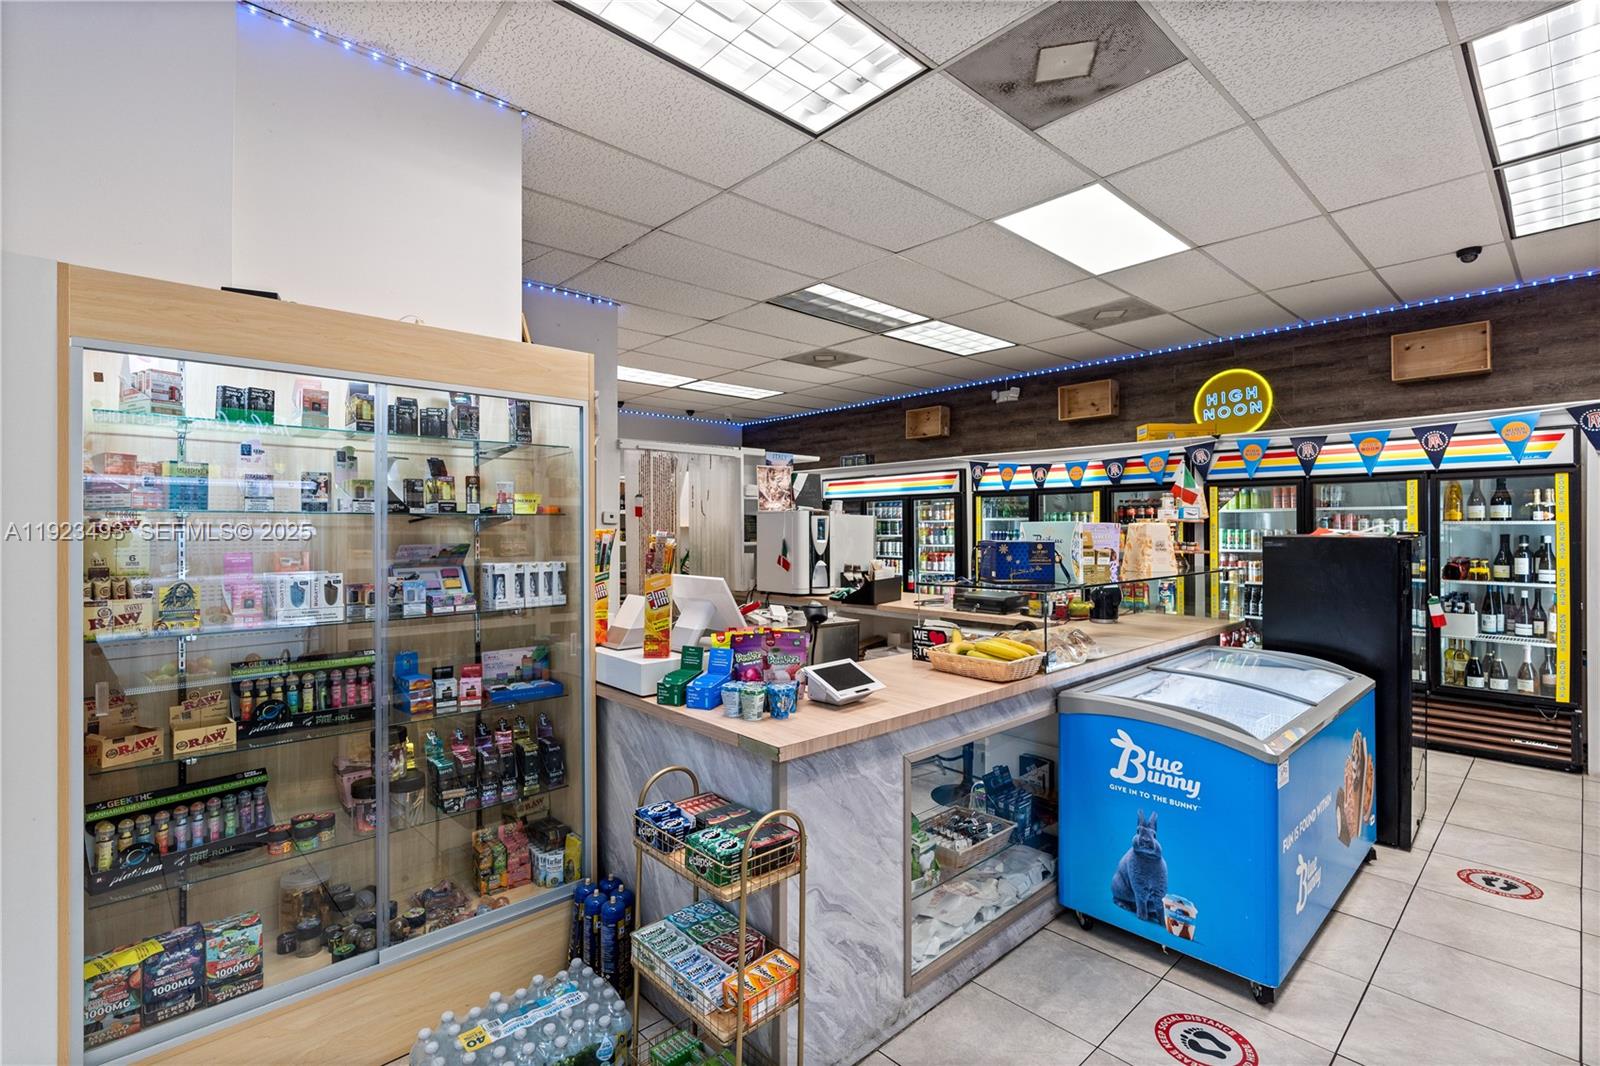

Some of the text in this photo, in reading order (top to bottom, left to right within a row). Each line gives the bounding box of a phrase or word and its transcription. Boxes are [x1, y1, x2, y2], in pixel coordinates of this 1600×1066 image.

[1206, 386, 1258, 406] HIGH
[1203, 400, 1263, 421] NOON
[88, 611, 142, 630] RAW
[913, 629, 929, 640] WE
[183, 695, 220, 711] RAW
[117, 735, 158, 756] RAW
[188, 730, 228, 748] RAW
[1110, 729, 1184, 784] Blue
[107, 792, 152, 808] GEEK THC
[1109, 783, 1127, 794] GIVE
[1128, 788, 1138, 796] IN
[1139, 791, 1151, 799] TO
[1152, 794, 1168, 804] THE
[524, 797, 545, 810] RAW
[87, 806, 125, 821] CANNABIS
[1283, 832, 1294, 853] FUN
[1294, 826, 1299, 842] IS
[1299, 808, 1317, 836] FOUND
[713, 914, 737, 927] Extra
[640, 926, 664, 940] Trident
[693, 924, 717, 937] Extra
[650, 934, 674, 948] Trident
[711, 938, 738, 952] Extra
[662, 943, 685, 957] Trident
[674, 953, 697, 966] Trident
[772, 953, 792, 969] Trident
[216, 959, 255, 978] 1000MG
[686, 962, 710, 976] Trident
[754, 964, 776, 981] Trident
[152, 976, 196, 997] 1000MG
[699, 972, 722, 987] Trident
[216, 984, 255, 1002] SPLASH
[85, 999, 131, 1020] 1000MG
[1158, 1014, 1184, 1031] SOCIAL
[1183, 1014, 1237, 1037] DISTANCE
[466, 1035, 486, 1048] 40
[1157, 1030, 1173, 1049] KEEP
